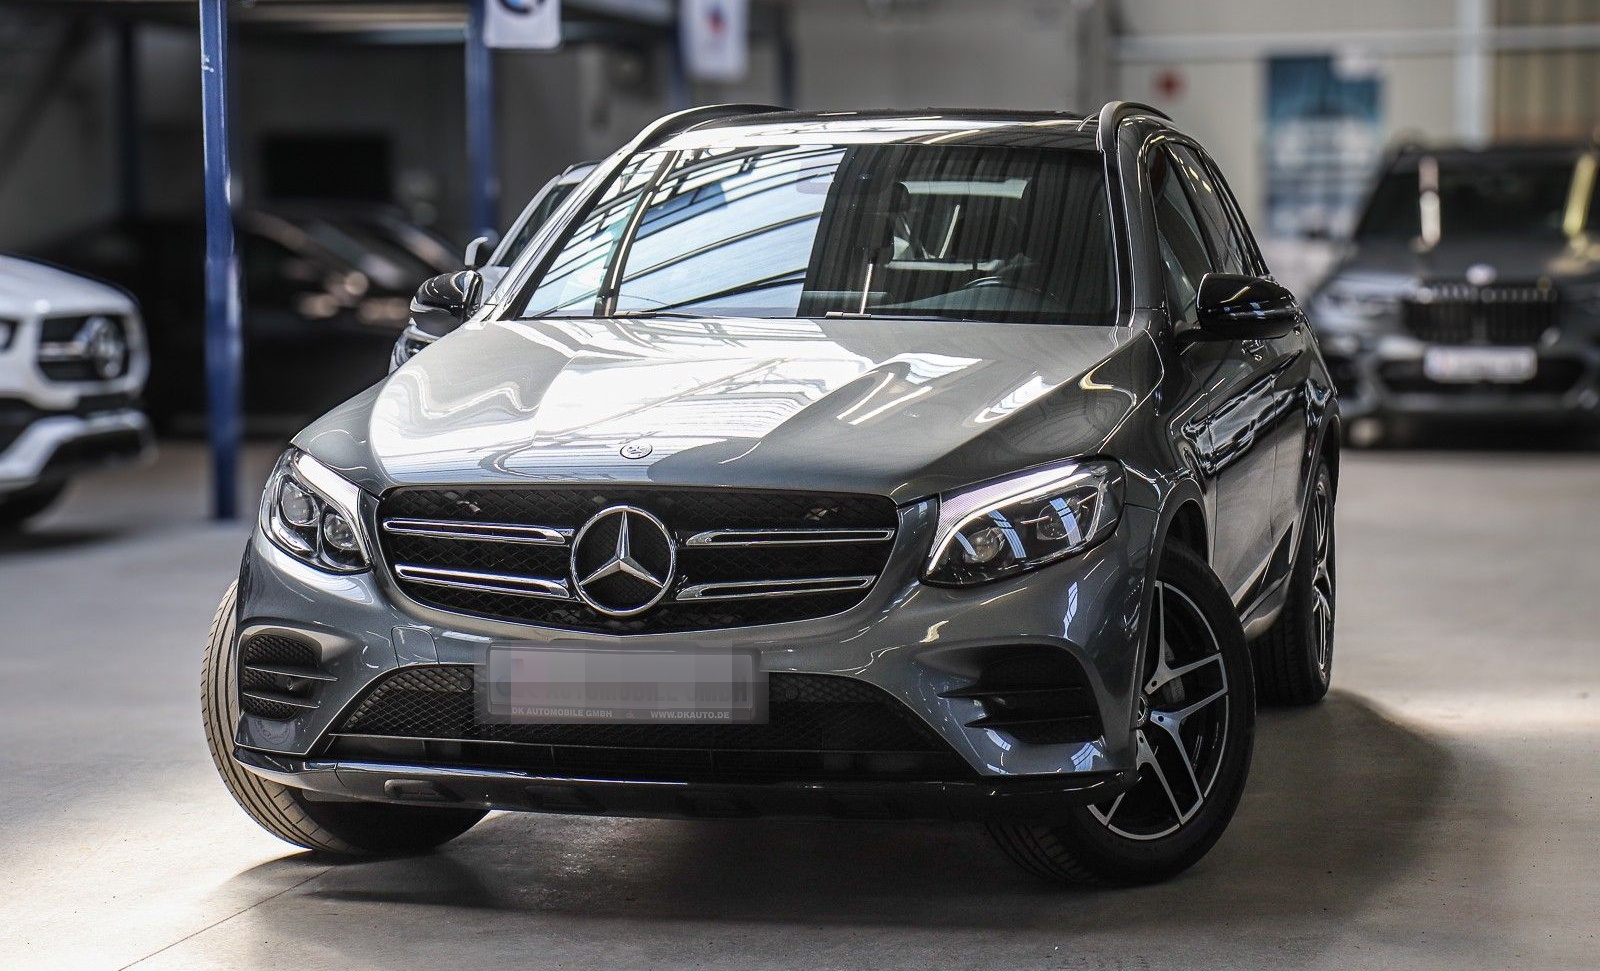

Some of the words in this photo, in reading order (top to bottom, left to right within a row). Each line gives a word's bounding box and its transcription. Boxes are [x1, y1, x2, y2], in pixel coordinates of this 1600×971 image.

[512, 707, 524, 715] DK
[526, 707, 584, 717] AUTOMOBILE
[586, 709, 612, 718] GMBH
[650, 710, 730, 719] WWW.DKAUTO.DE
